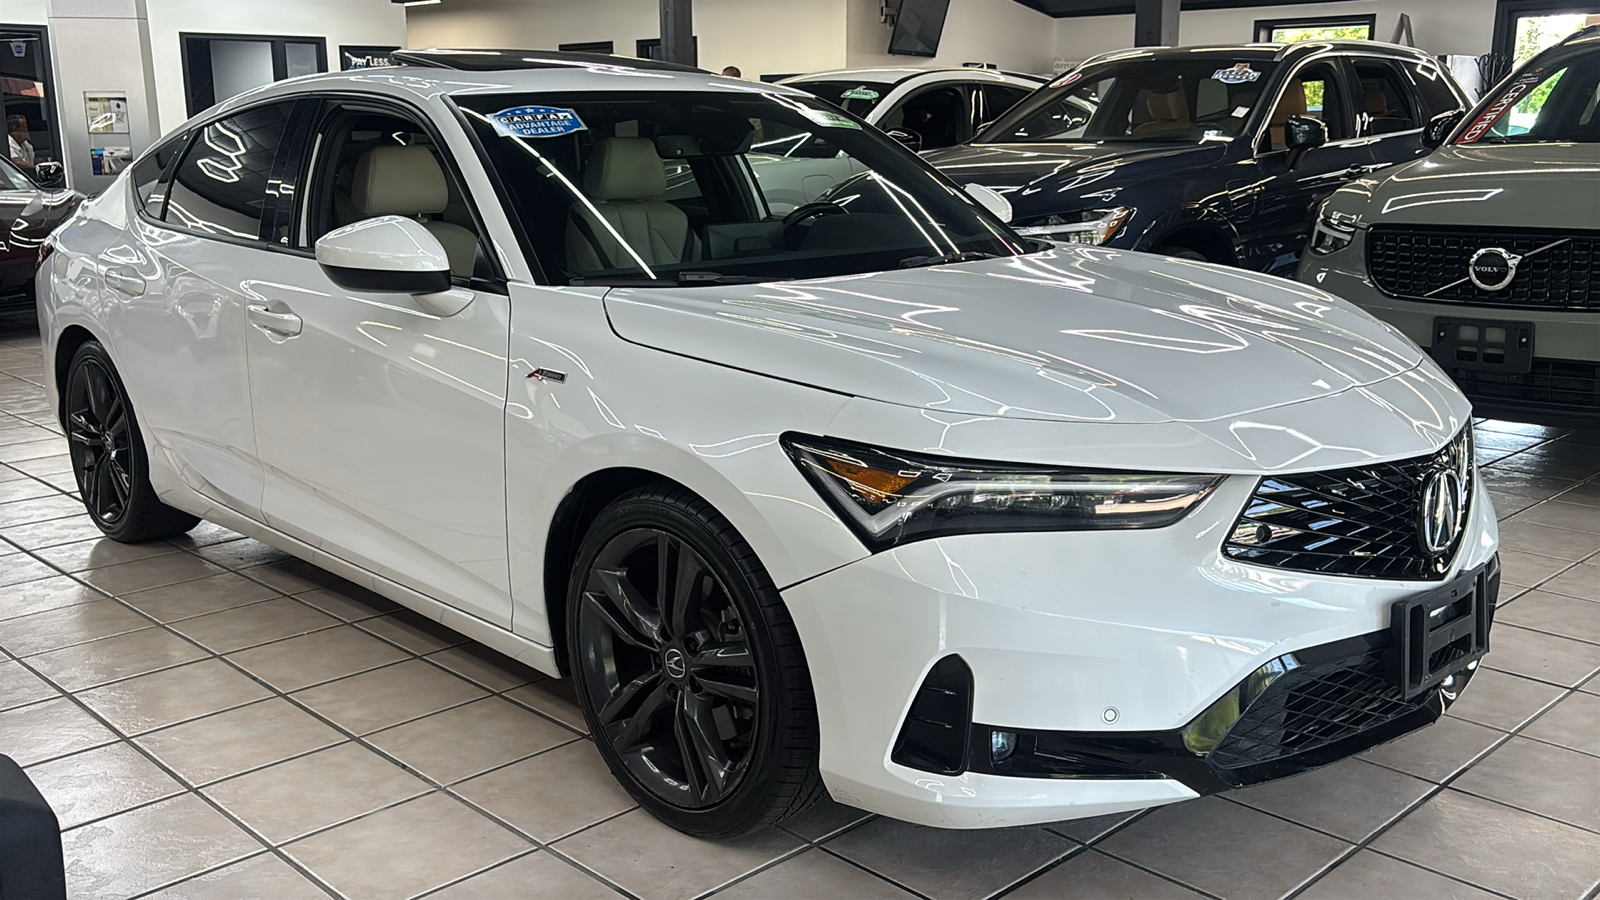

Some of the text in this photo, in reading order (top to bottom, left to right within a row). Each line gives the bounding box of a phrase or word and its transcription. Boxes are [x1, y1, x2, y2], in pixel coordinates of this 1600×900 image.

[1464, 84, 1527, 140] CERTIFIED
[498, 113, 573, 123] CARFAX
[508, 119, 572, 130] ADVANTAGE
[522, 126, 566, 135] DEALER
[1474, 265, 1508, 273] VOLVO
